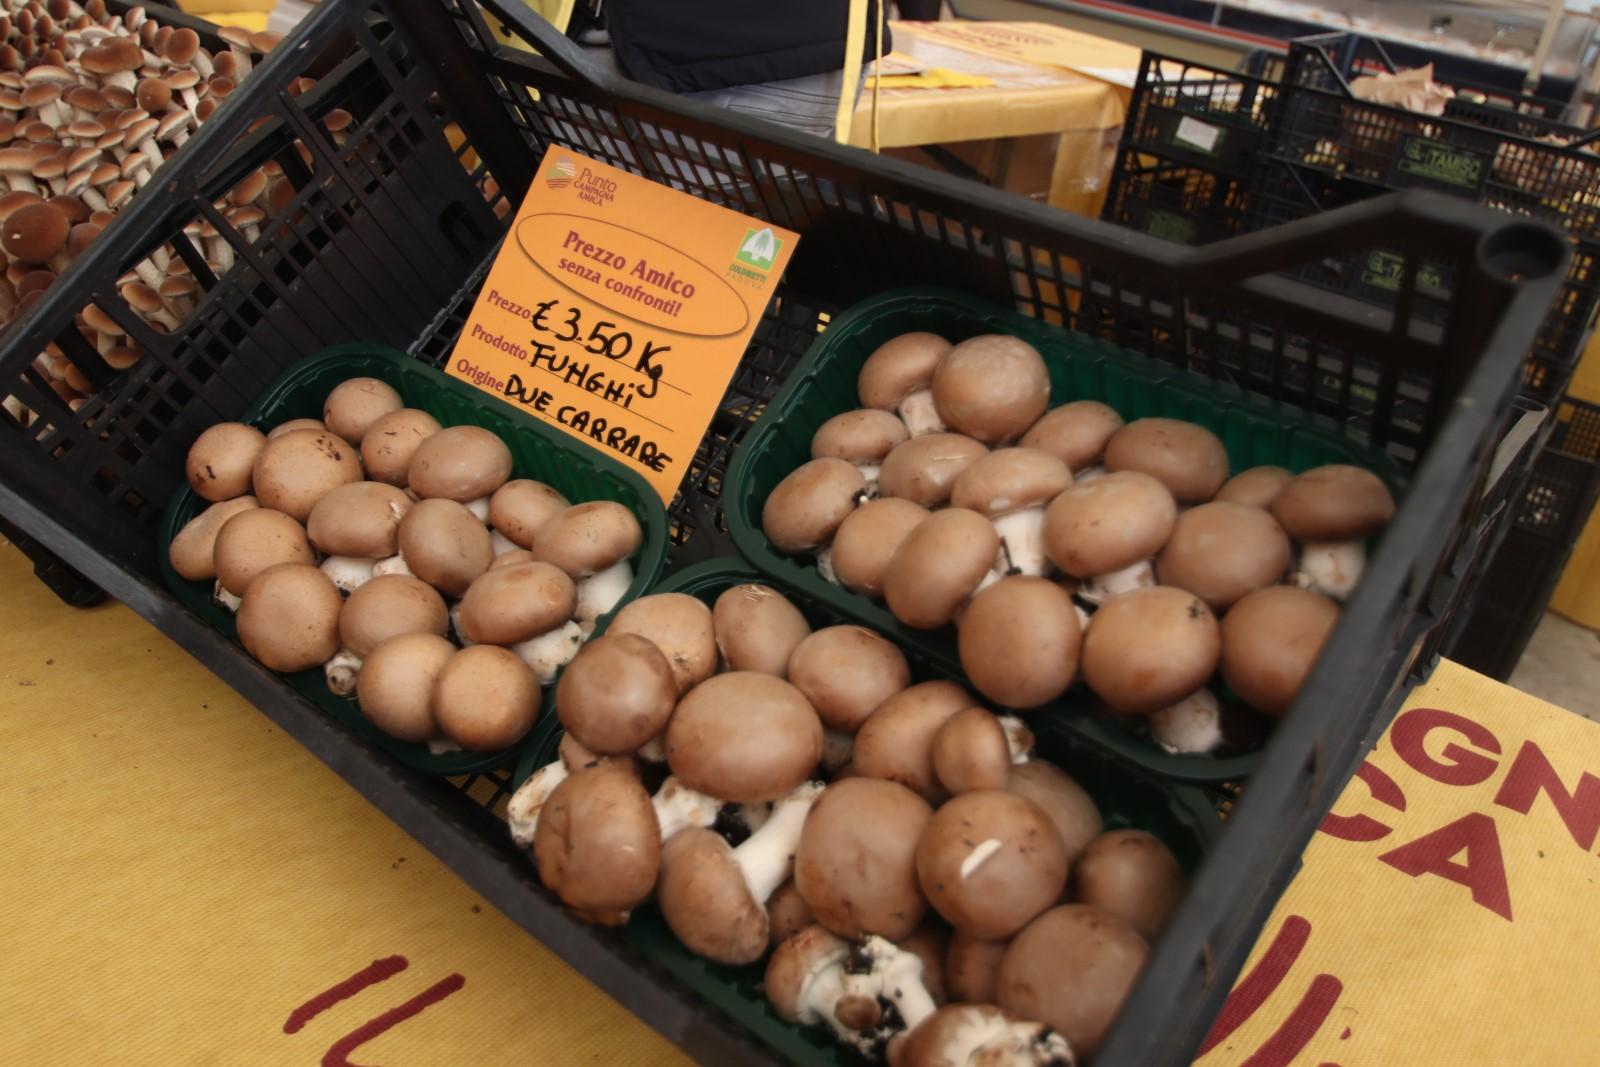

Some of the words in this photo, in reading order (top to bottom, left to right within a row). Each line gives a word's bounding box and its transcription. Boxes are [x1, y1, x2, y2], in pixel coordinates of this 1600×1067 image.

[573, 182, 614, 203] CAMPAGNA
[577, 192, 603, 208] AMICA
[579, 168, 617, 193] Punto
[558, 257, 602, 285] senza
[604, 276, 683, 318] confronti!
[562, 230, 626, 271] Prezzo
[631, 258, 695, 300] Amico
[471, 323, 528, 361] Prodotto
[487, 289, 532, 321] Prezzo
[554, 307, 633, 360] 3.50
[456, 358, 504, 394] Origine
[503, 373, 554, 413] DUE
[556, 405, 673, 474] CARRARE
[1390, 707, 1600, 858] GN
